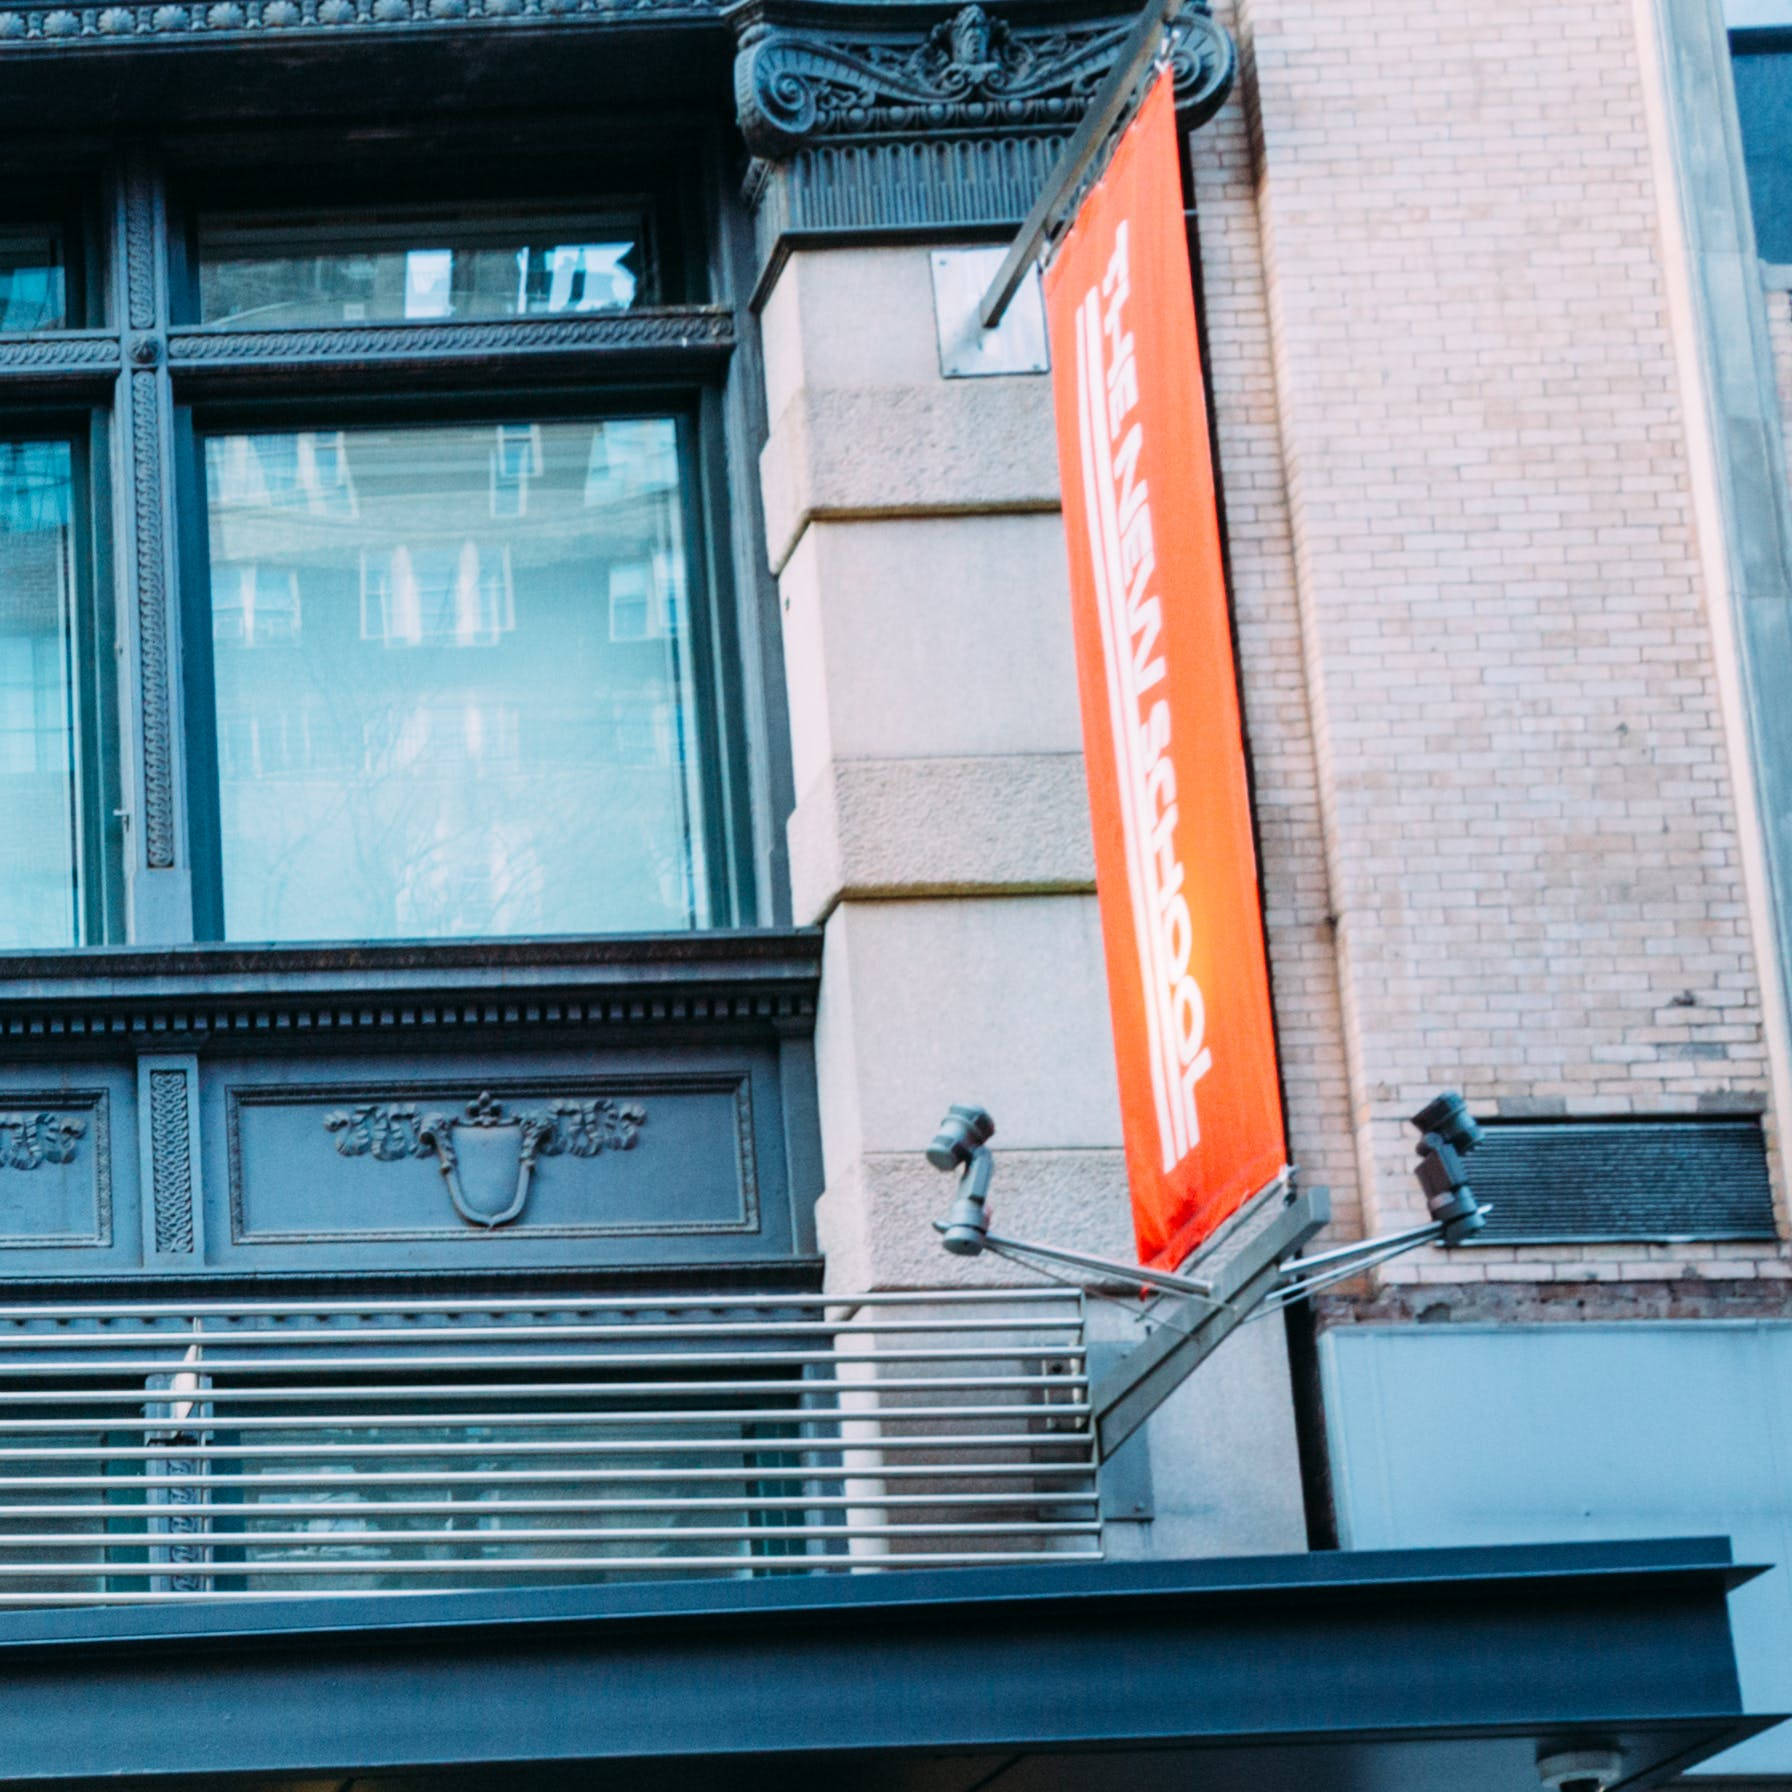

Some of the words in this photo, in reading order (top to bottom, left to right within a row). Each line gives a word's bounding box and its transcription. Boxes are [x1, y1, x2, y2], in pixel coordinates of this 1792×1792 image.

[1102, 219, 1138, 441] THE
[1114, 422, 1166, 694] NEW
[1138, 698, 1213, 1147] SCHOOL
